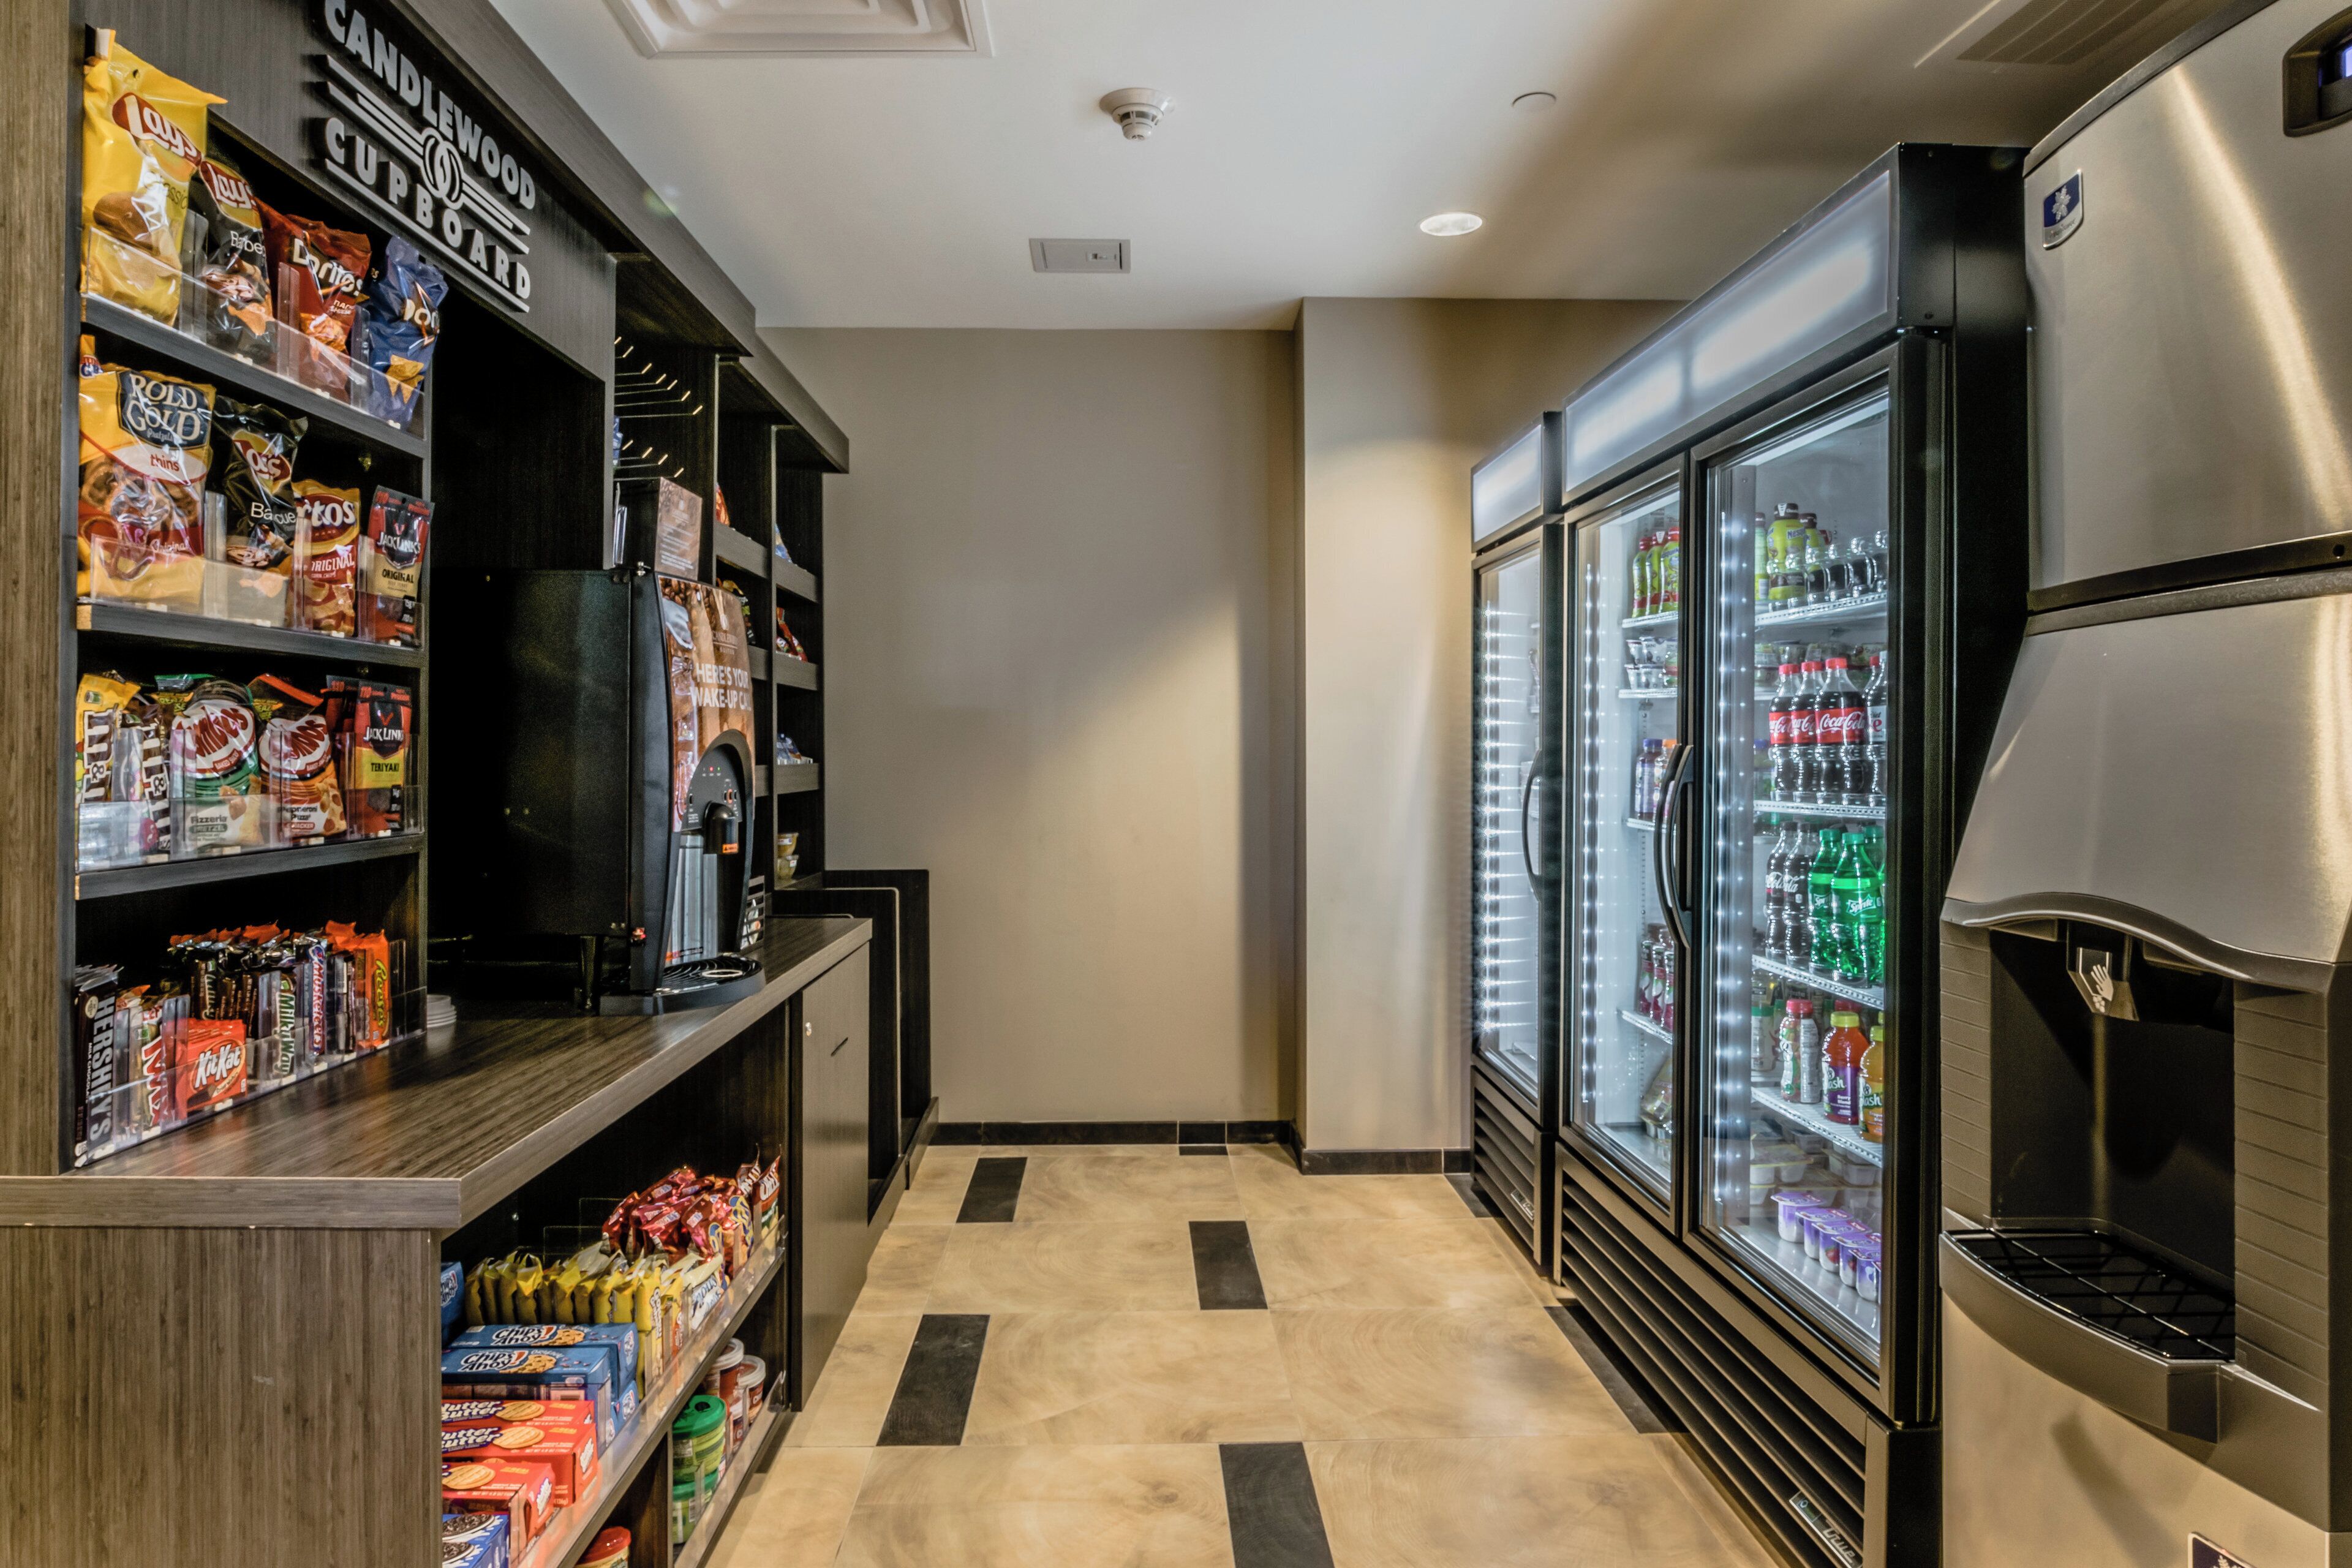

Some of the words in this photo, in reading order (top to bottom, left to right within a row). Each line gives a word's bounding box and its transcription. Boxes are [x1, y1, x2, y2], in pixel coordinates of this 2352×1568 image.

[325, 0, 536, 210] CANDLEWOOD
[325, 117, 532, 300] CUPBOARD
[129, 373, 198, 410] ROLD
[126, 399, 202, 441] GOLD
[150, 453, 180, 472] thins
[382, 568, 414, 584] ORIGINAL
[696, 662, 733, 687] HERE'S
[733, 666, 749, 690] YOUR
[689, 686, 738, 709] WAKE-UP
[1819, 710, 1865, 733] Coca-Cola
[363, 726, 383, 741] JACK
[371, 762, 399, 773] TERIYAKI
[190, 815, 227, 824] Pizzeria
[1849, 898, 1873, 913] Sprite
[494, 1327, 543, 1339] Chips
[461, 1352, 514, 1365] Chips
